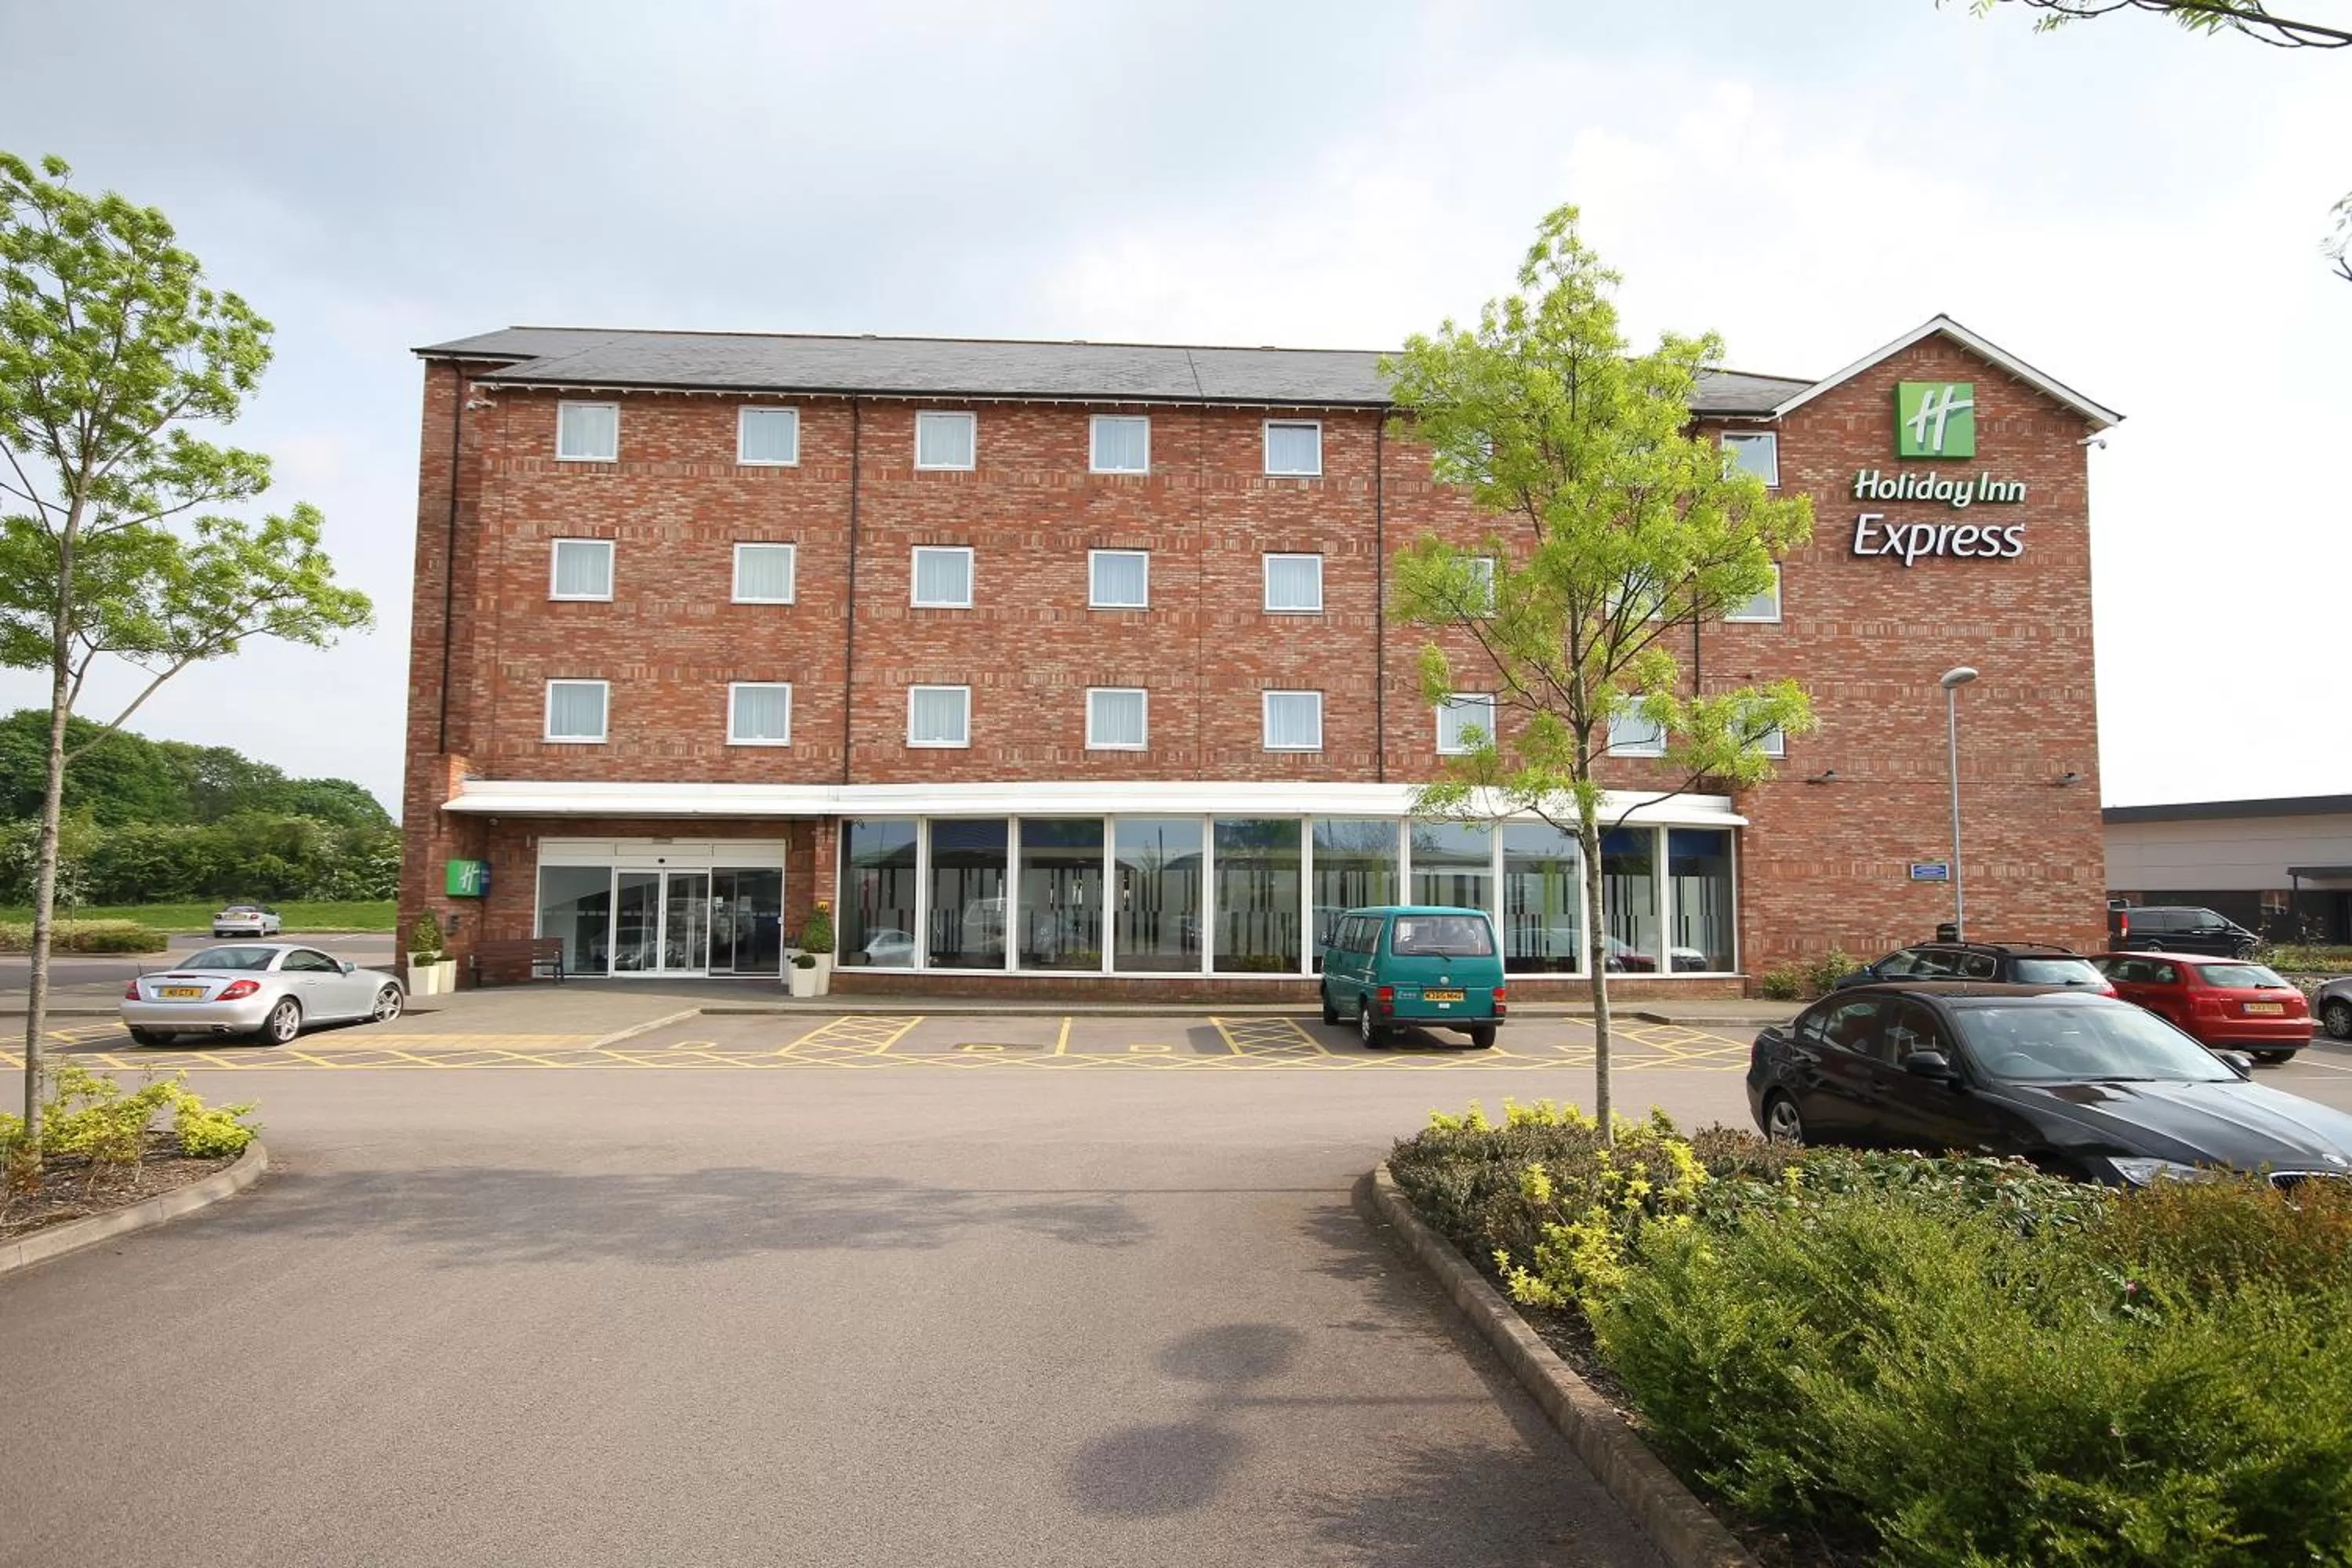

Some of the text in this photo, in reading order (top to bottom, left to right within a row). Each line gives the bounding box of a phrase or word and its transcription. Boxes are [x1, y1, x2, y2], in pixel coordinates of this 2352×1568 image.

[1854, 470, 2027, 507] Holiday Inn
[1853, 514, 2025, 567] Express
